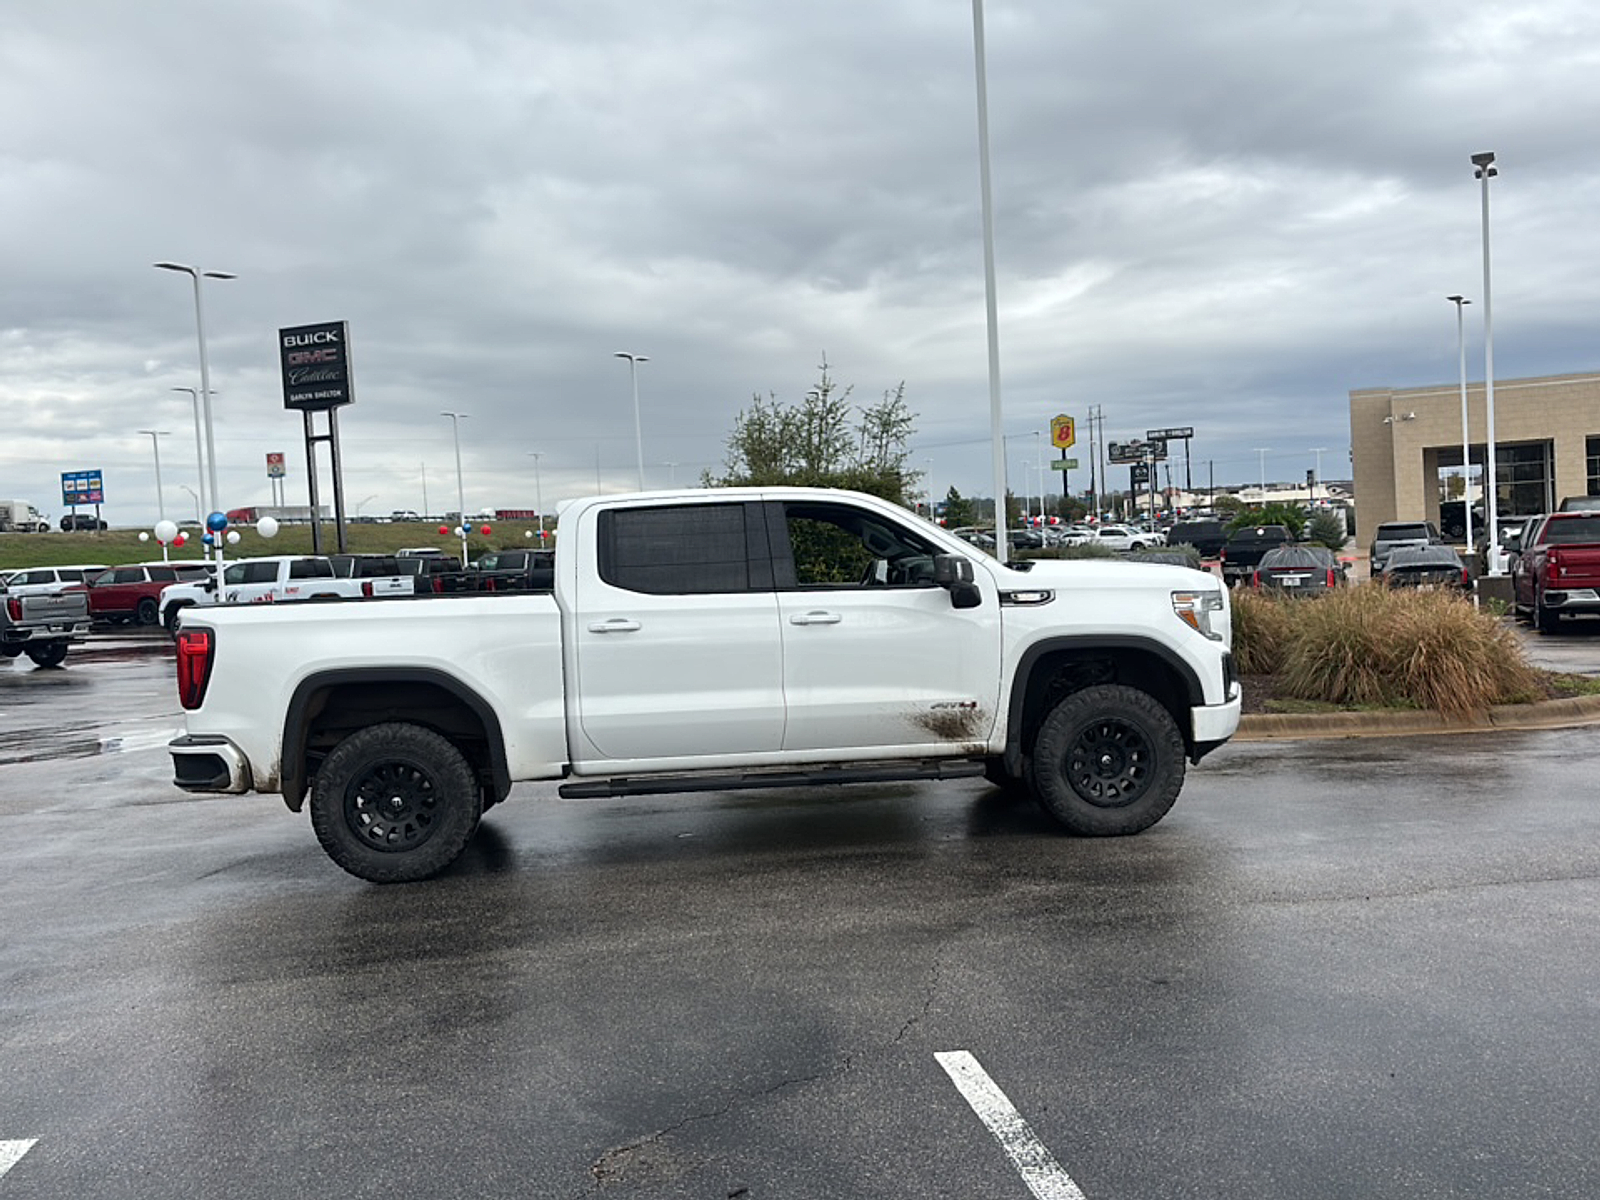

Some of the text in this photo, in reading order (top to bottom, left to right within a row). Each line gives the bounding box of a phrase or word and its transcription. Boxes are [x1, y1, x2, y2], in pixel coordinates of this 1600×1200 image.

[284, 330, 339, 347] BUICK
[288, 348, 337, 364] GMC
[1058, 425, 1071, 441] 8
